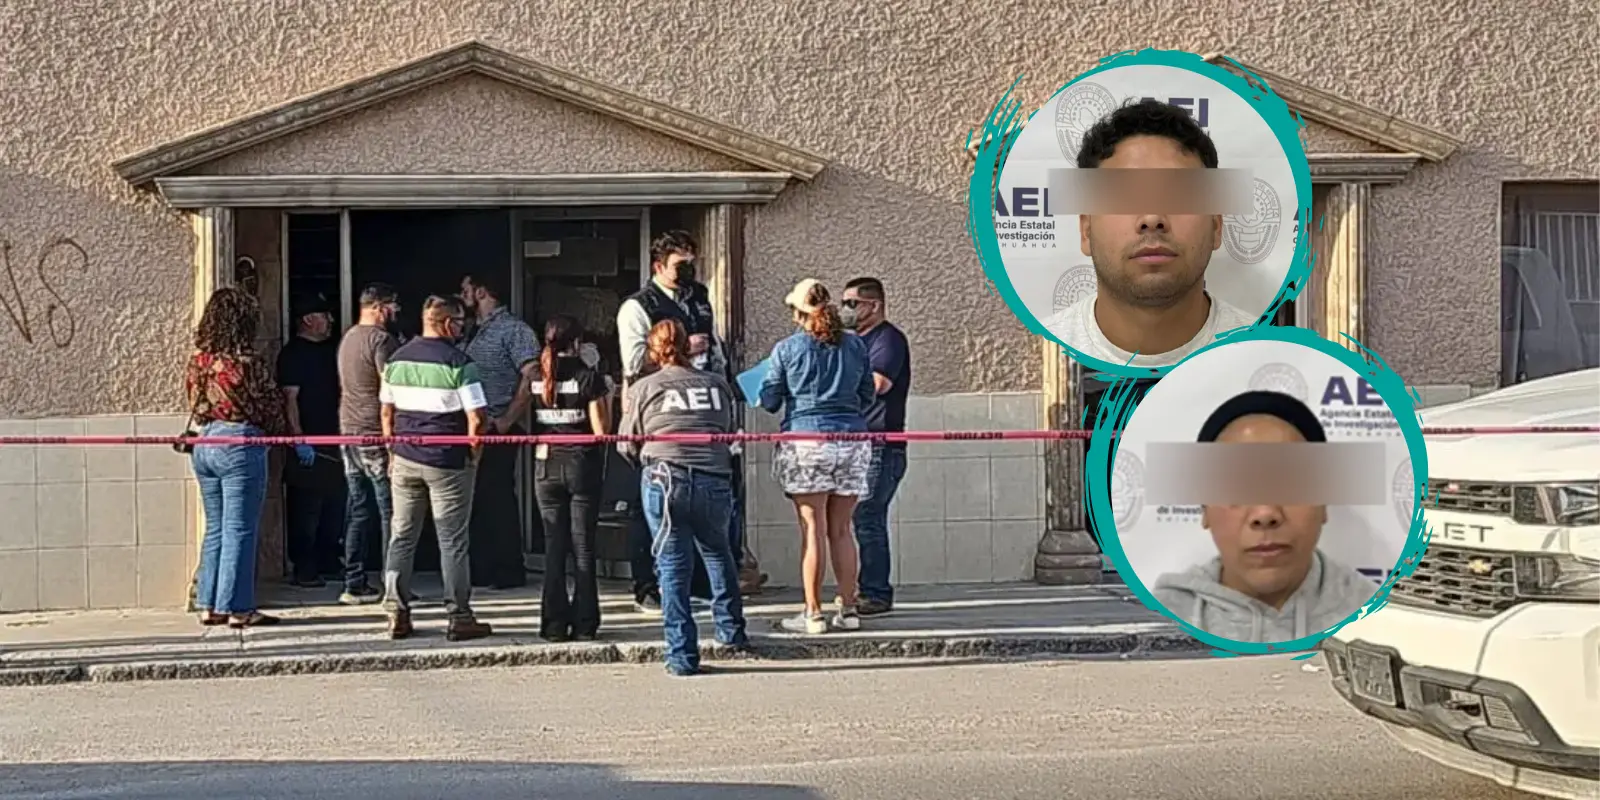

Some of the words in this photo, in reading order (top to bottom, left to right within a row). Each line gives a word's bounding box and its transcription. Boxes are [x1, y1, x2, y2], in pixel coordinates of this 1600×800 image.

[995, 219, 1017, 229] ncia
[1020, 219, 1055, 230] Estatal
[660, 387, 722, 413] AEI
[1320, 376, 1384, 406] AE
